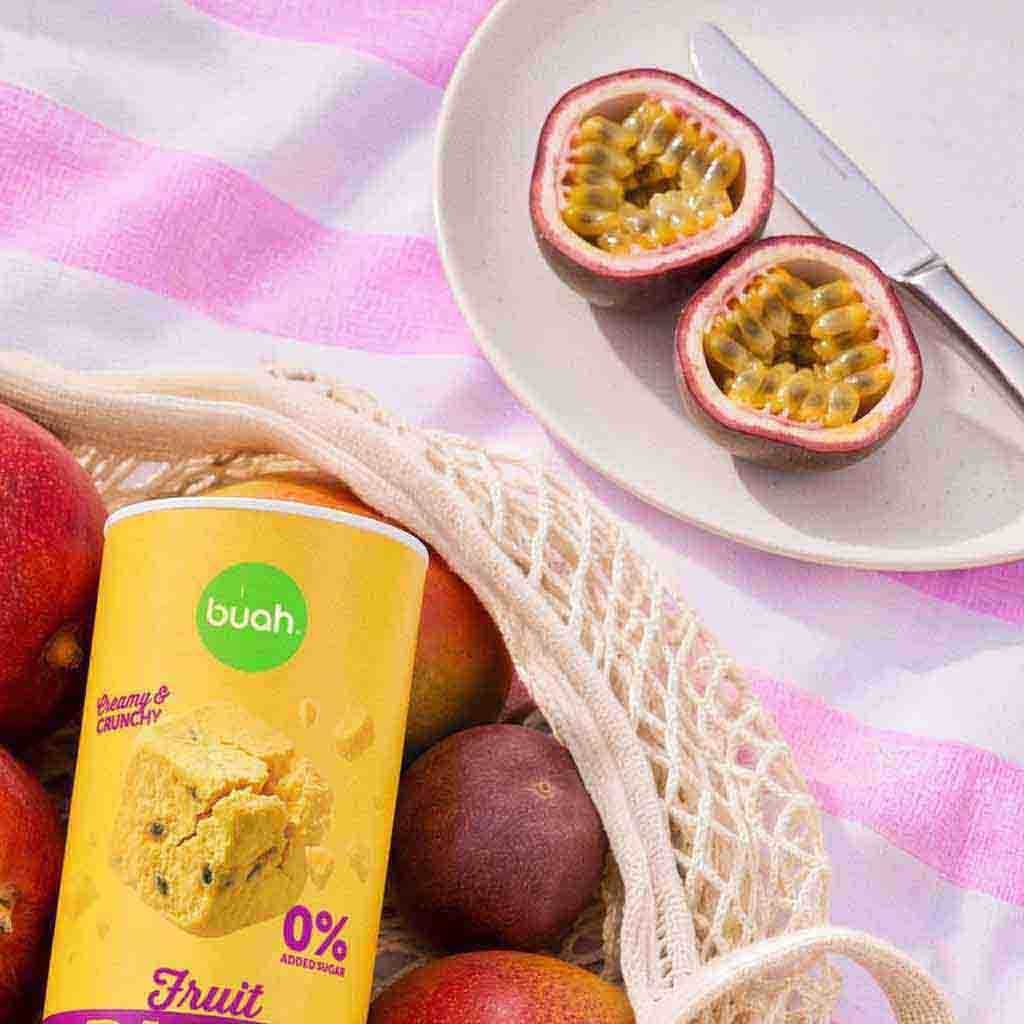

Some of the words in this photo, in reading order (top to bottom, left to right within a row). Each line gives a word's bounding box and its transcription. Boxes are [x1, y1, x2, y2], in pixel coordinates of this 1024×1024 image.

[96, 692, 150, 717] Creamy
[153, 685, 171, 705] &
[96, 708, 162, 734] CRUNCHY
[283, 904, 349, 962] 0%
[280, 953, 316, 970] ADDED
[316, 961, 345, 978] SUGAR
[147, 967, 265, 1019] Fruit
